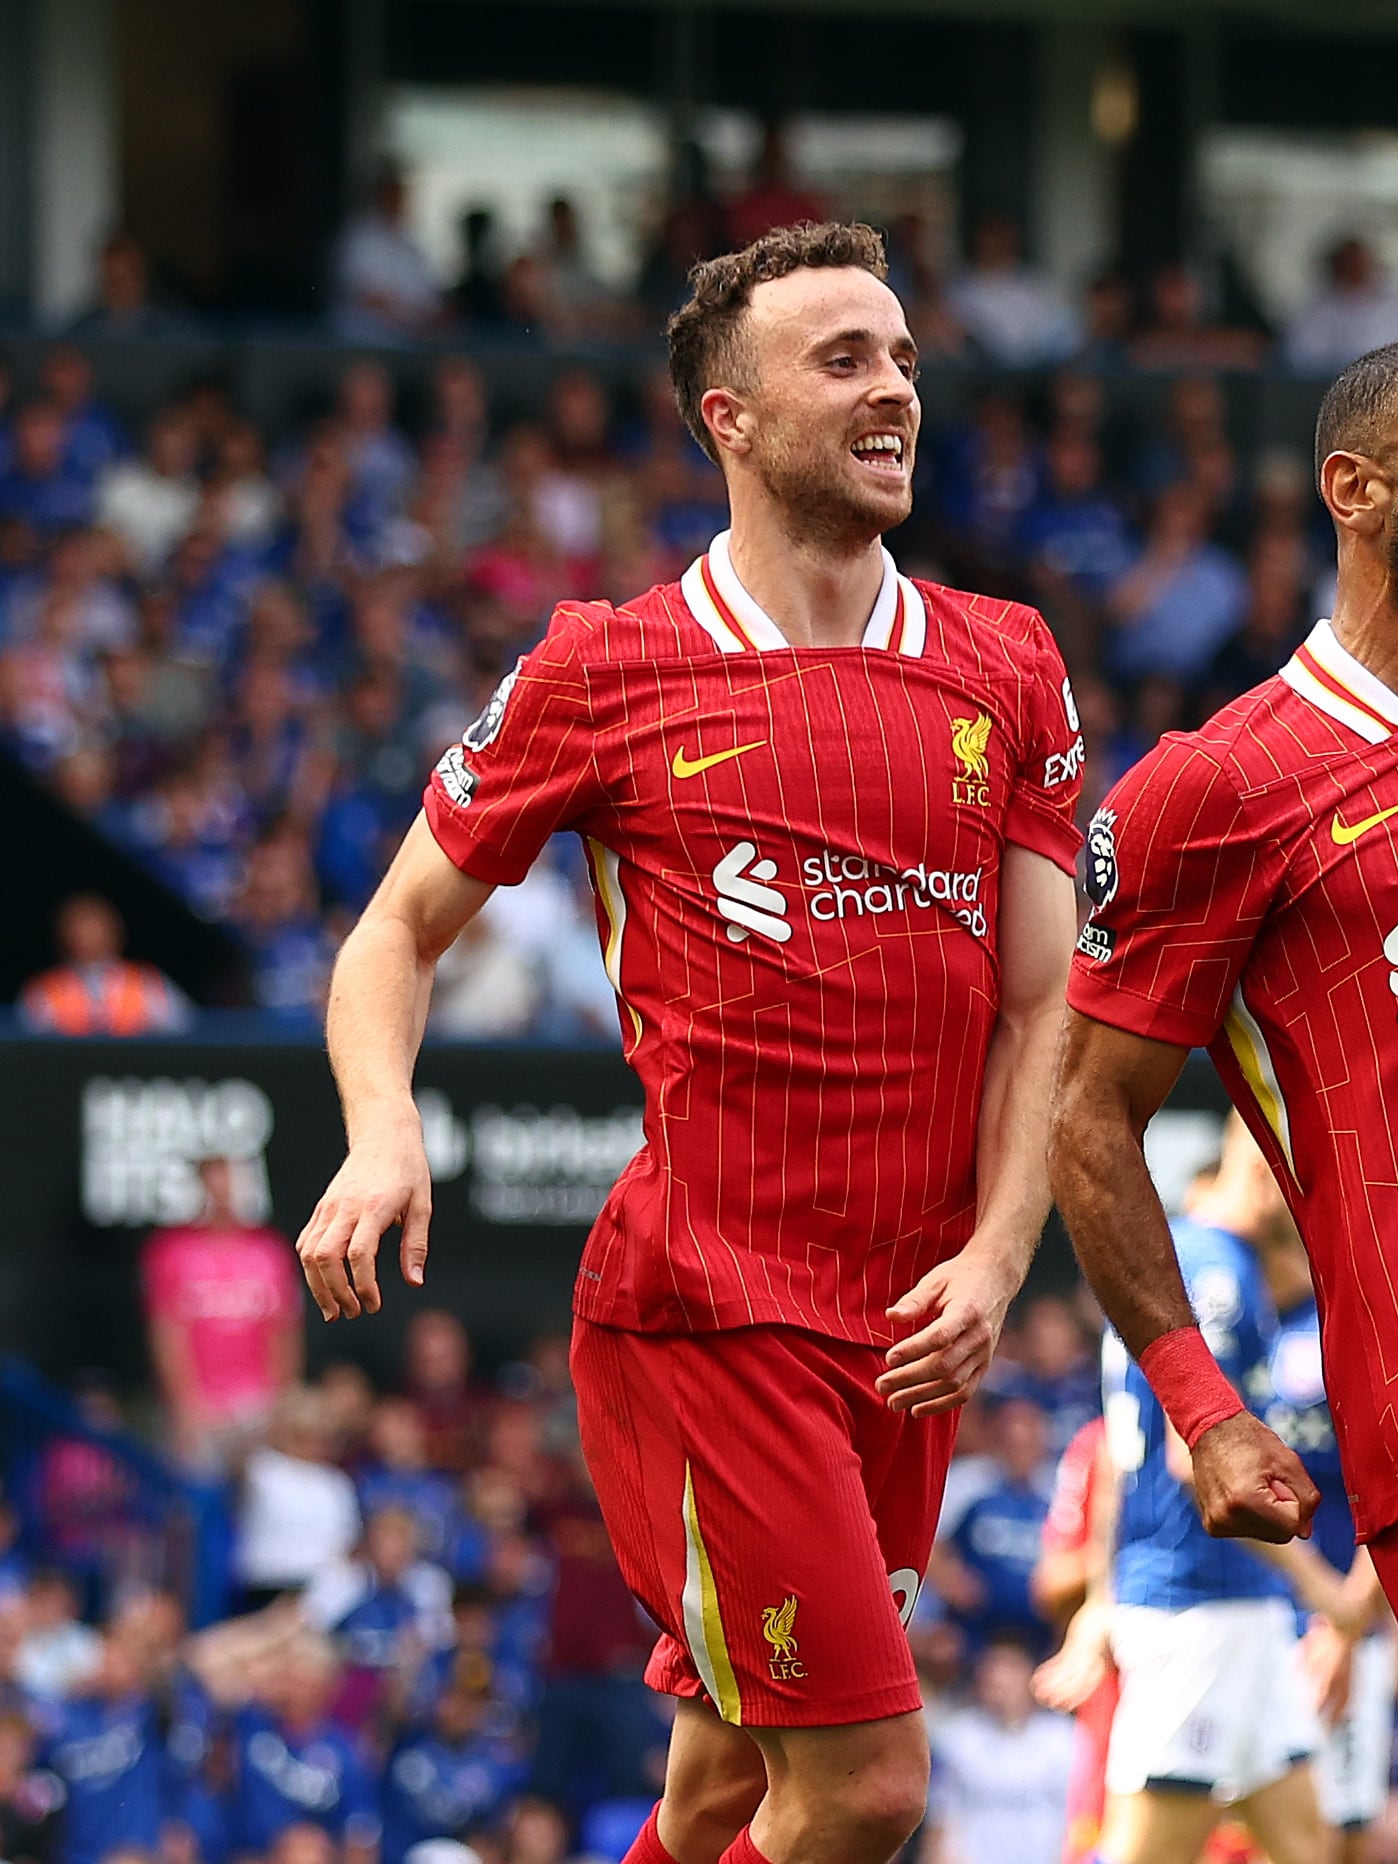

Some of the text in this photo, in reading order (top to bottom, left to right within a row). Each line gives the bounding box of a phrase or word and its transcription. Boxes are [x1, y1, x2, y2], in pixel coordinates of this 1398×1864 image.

[951, 782, 991, 807] L.F.C.
[810, 883, 987, 937] charted
[768, 1662, 808, 1680] L.F.C.
